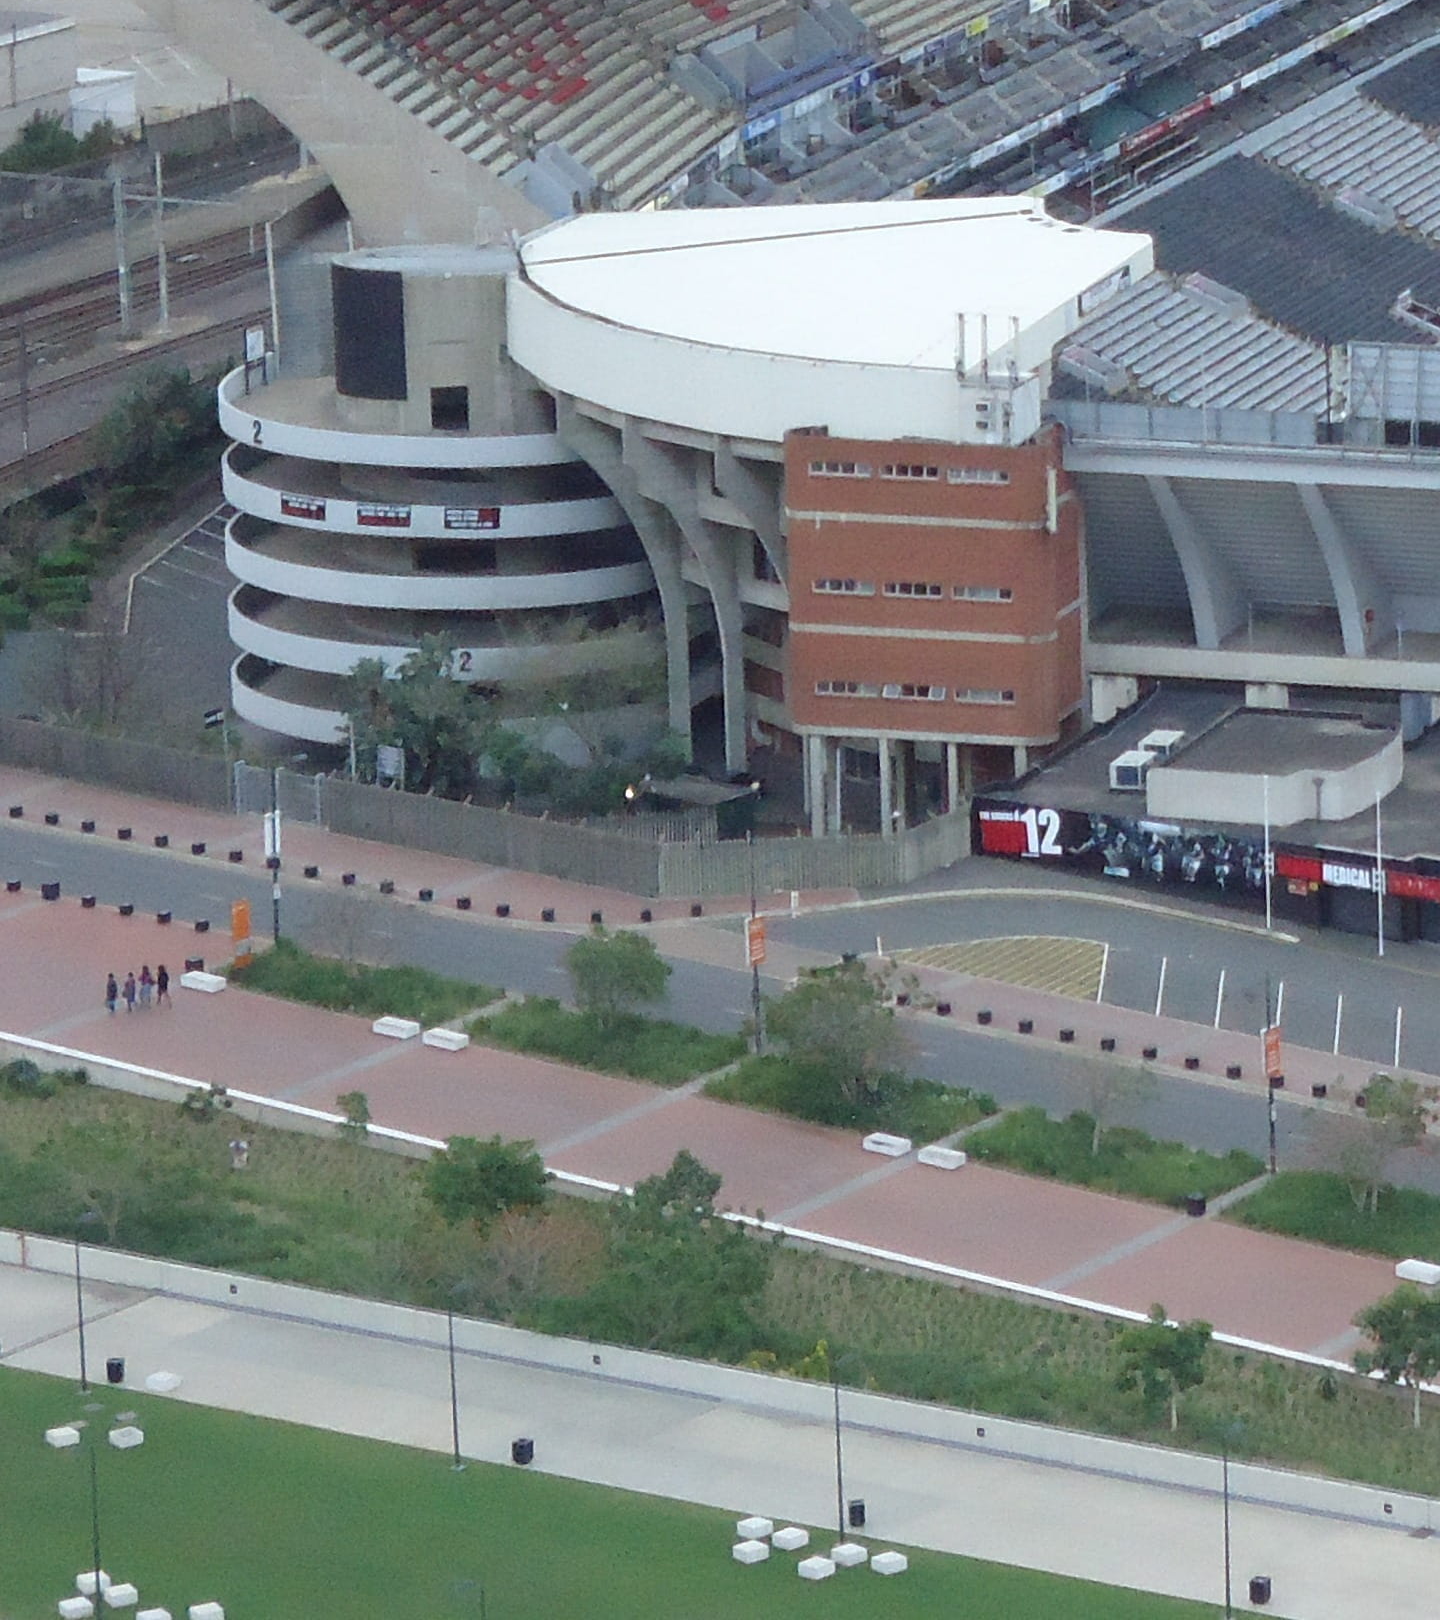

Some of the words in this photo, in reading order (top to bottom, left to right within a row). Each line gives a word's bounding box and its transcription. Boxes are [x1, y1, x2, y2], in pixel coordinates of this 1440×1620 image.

[252, 419, 263, 445] 2
[1021, 808, 1064, 856] 12
[1322, 863, 1371, 889] MEDICAL
